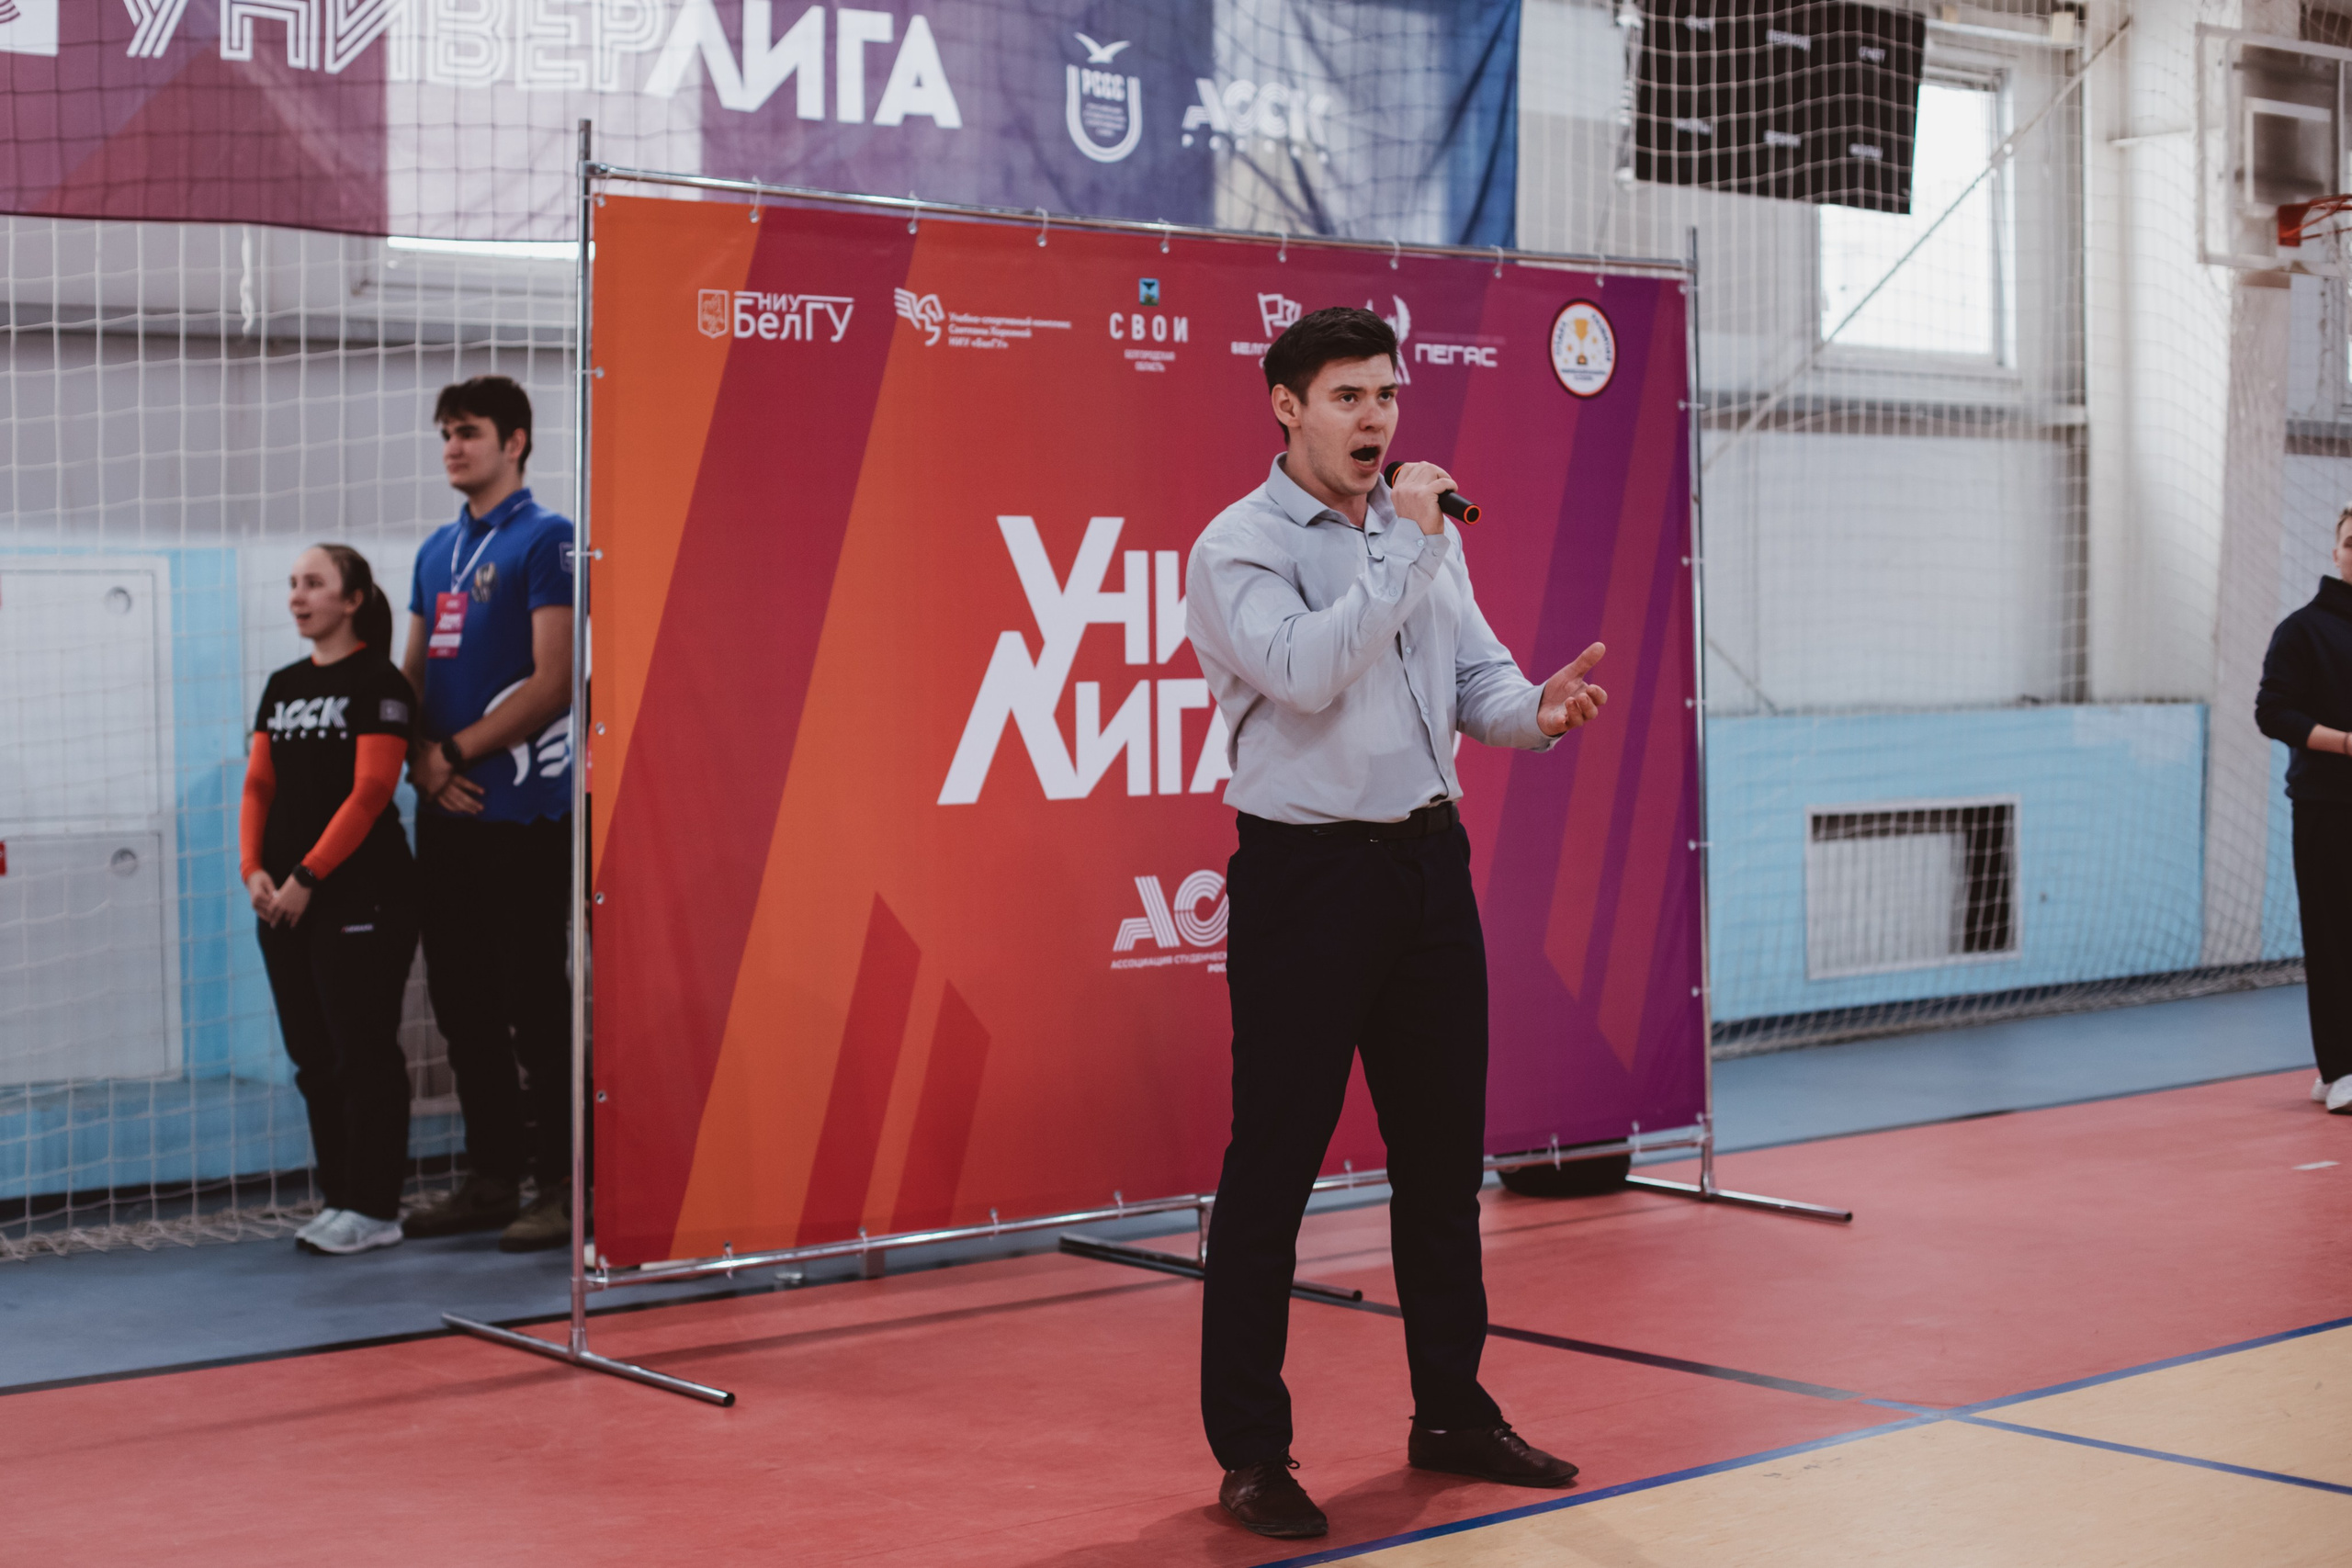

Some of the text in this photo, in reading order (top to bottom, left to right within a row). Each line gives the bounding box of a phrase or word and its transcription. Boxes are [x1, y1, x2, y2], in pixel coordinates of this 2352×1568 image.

[758, 292, 802, 313] НИУ
[733, 298, 854, 343] БелГУ
[1109, 311, 1189, 343] СВОИ
[1415, 343, 1498, 367] ПЕГАС
